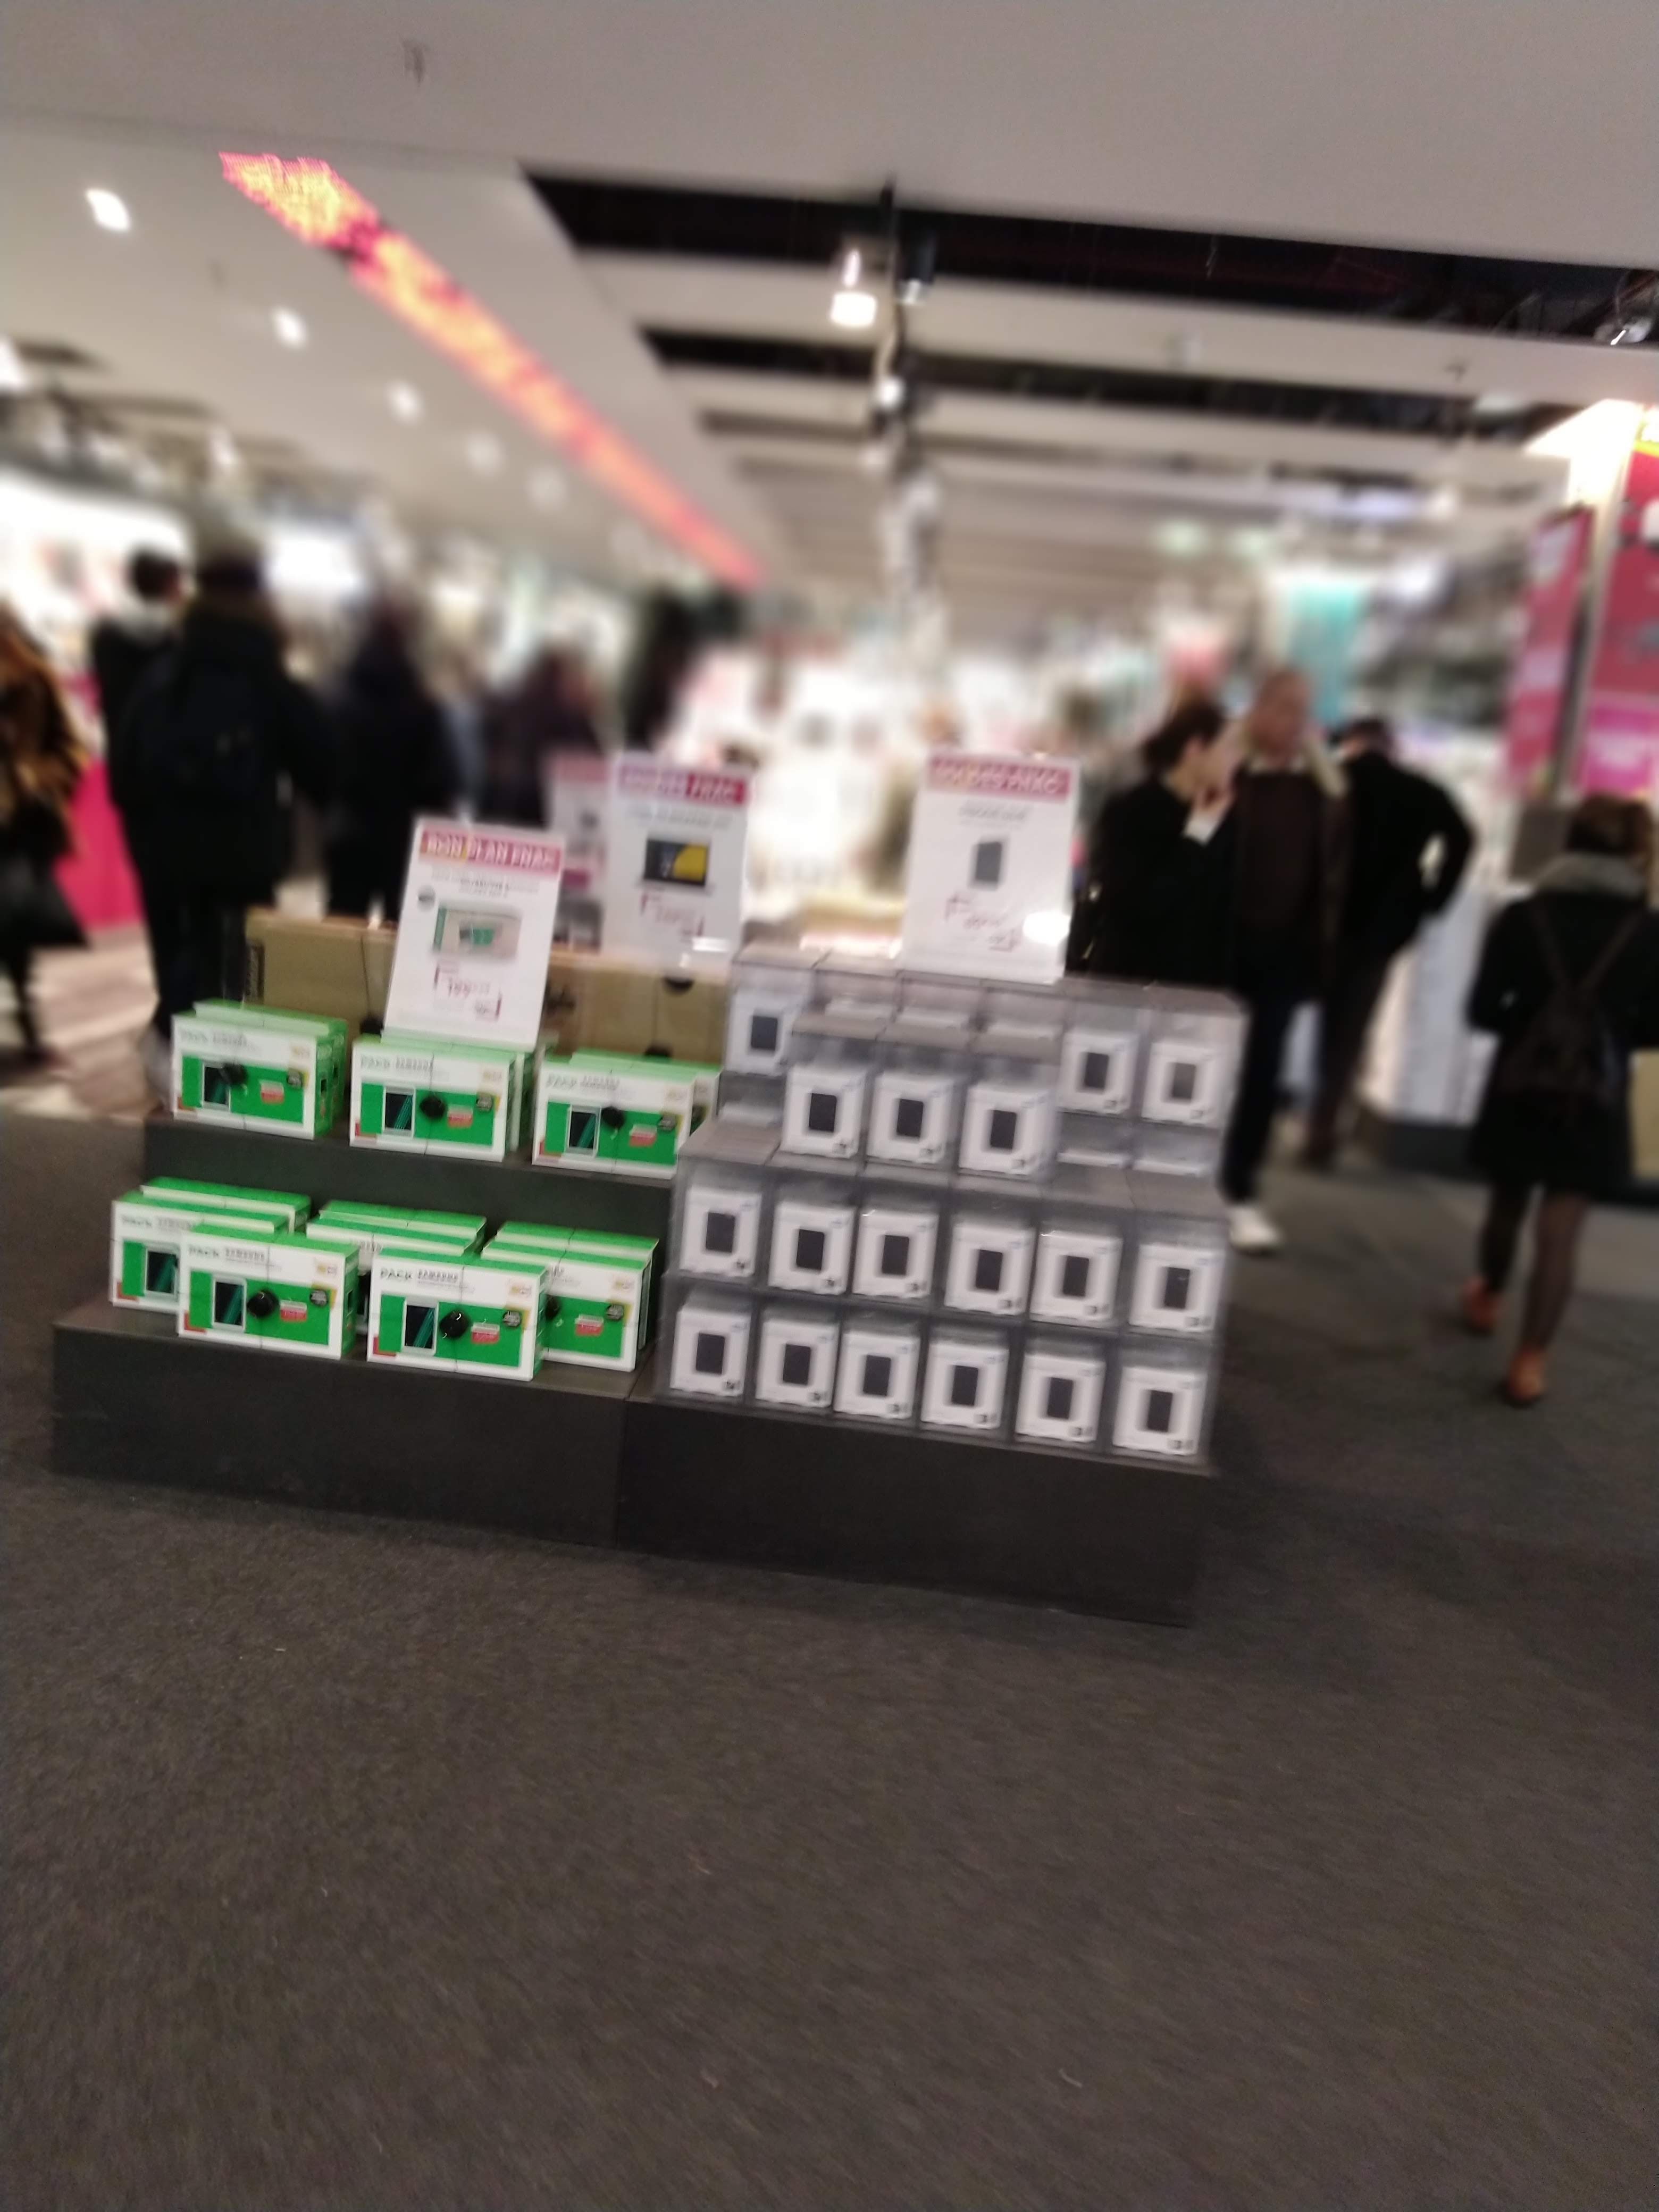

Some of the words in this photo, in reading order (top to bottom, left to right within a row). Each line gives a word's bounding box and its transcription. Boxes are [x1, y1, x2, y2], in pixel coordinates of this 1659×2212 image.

[426, 834, 463, 858] BON
[466, 838, 507, 865] PLAN
[509, 842, 556, 870] FNAC
